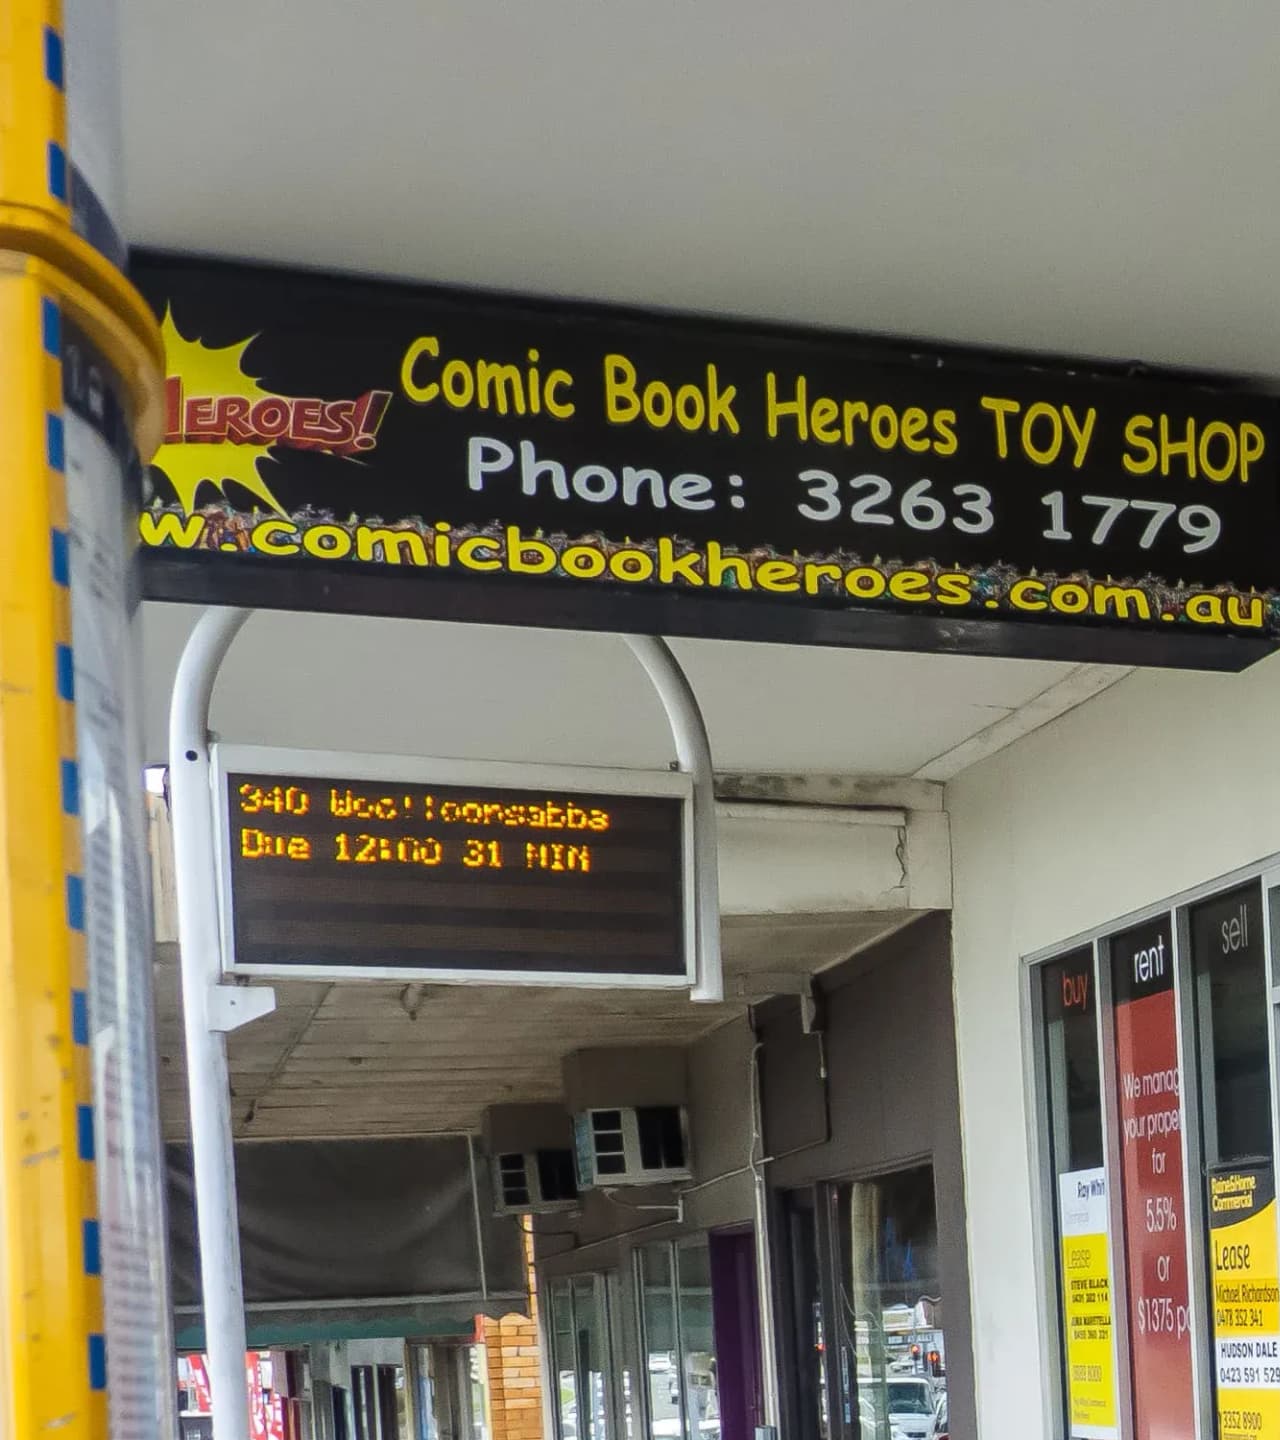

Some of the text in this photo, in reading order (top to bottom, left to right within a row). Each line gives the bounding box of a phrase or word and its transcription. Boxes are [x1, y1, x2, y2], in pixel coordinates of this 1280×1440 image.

[399, 336, 1265, 483] Comic Book Heroes TOY SHOP
[467, 436, 1222, 554] Phone: 3263 1779
[139, 511, 1264, 628] w.comicbookheroes.com.au
[239, 783, 310, 816] 340
[240, 828, 312, 860] Due
[462, 839, 504, 869] 31
[526, 842, 592, 874] MIN
[1222, 903, 1248, 954] sell
[1134, 936, 1165, 983] rent
[1062, 970, 1088, 1011] buy
[1124, 1068, 1180, 1100] We manag
[1123, 1108, 1182, 1145] your prope
[1151, 1147, 1166, 1174] for
[1146, 1197, 1177, 1233] 5.5%
[1157, 1255, 1170, 1282] or
[1215, 1239, 1251, 1271] Lease
[1216, 1282, 1280, 1303] Michael Richardson
[1138, 1296, 1176, 1337] $1375
[1221, 1341, 1278, 1358] HUDSON DALE
[1220, 1367, 1242, 1383] 0423
[1243, 1367, 1260, 1383] 591
